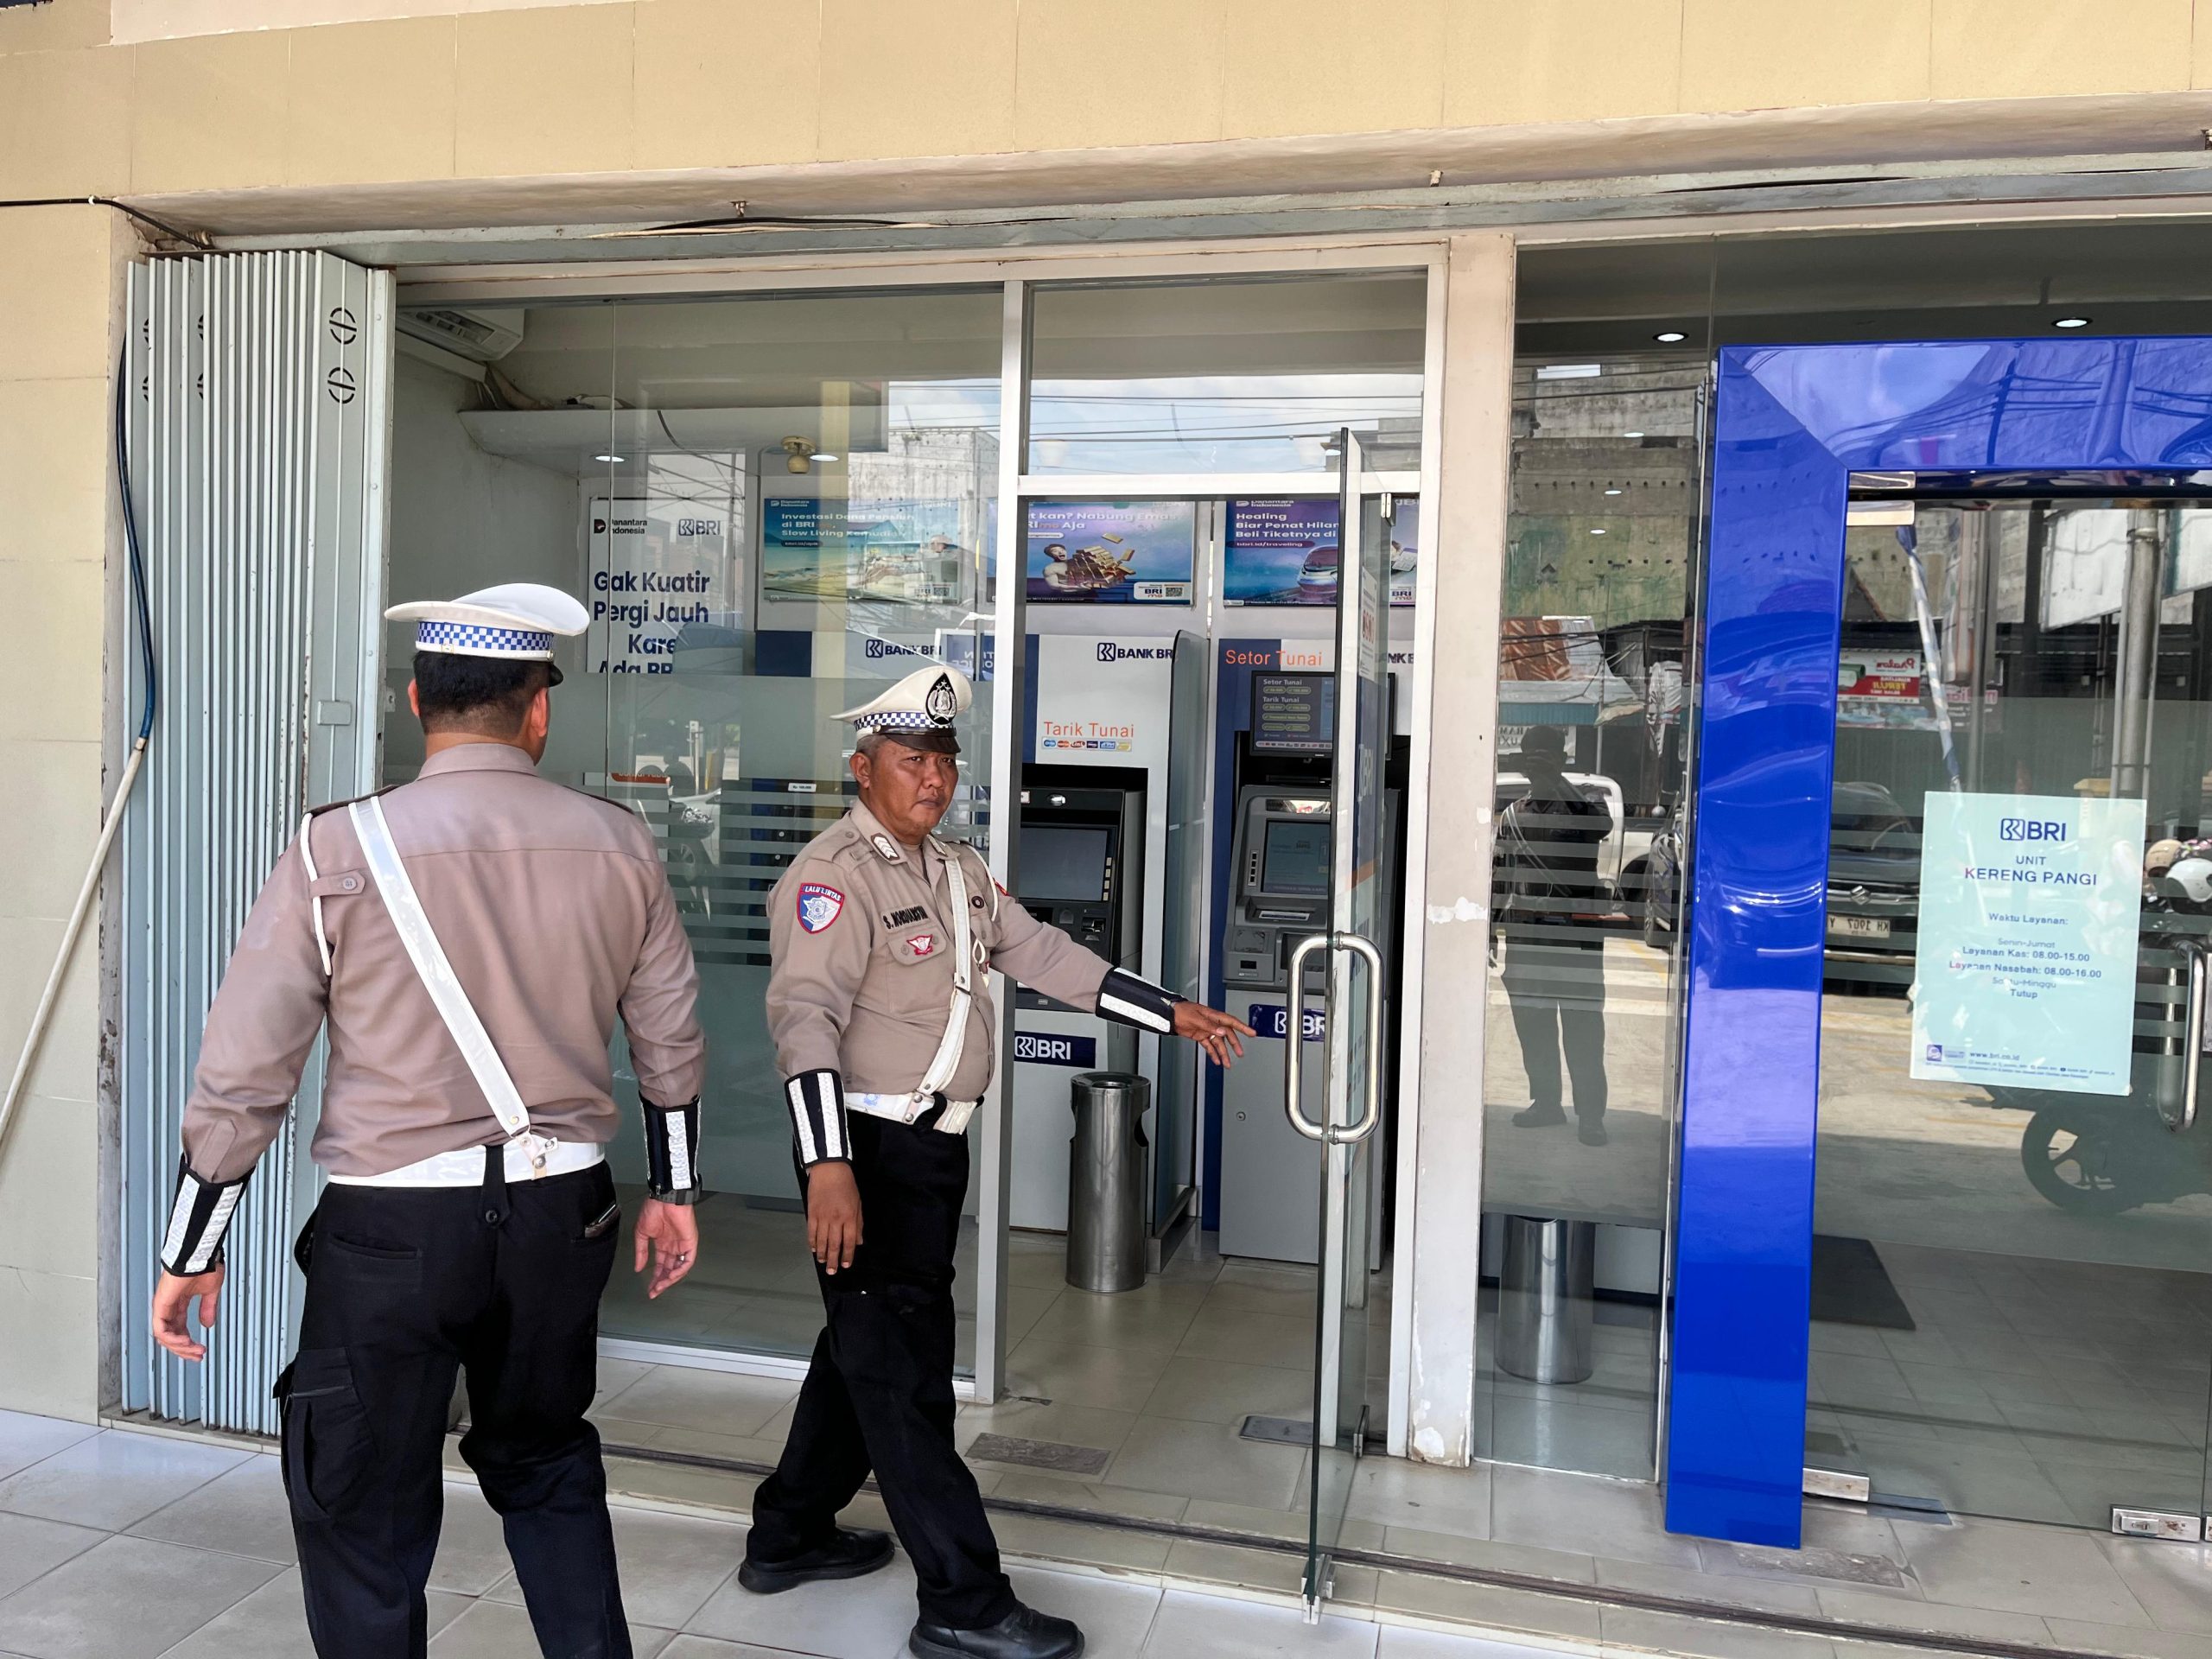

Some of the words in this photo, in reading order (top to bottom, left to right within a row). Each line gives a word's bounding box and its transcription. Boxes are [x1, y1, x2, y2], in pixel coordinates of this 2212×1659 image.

[1077, 512, 1133, 522] Nabung
[1236, 512, 1287, 521] Healing
[695, 520, 721, 536] BRI
[1062, 521, 1086, 531] Aja
[810, 530, 844, 538] Living
[1262, 531, 1320, 539] Tiketnya
[594, 570, 638, 592] Gak
[642, 569, 710, 593] Kuatir
[594, 599, 649, 629] Pergi
[652, 601, 709, 622] Jauh
[1117, 648, 1153, 659] BANK
[1225, 649, 1271, 664] Setor
[1274, 650, 1323, 666] Tunai
[1043, 721, 1084, 736] Tarik
[1089, 722, 1135, 738] Tunai
[2027, 821, 2067, 842] BRI
[2016, 855, 2047, 866] UNIT
[1965, 867, 2037, 883] KERENG
[2043, 871, 2097, 886] PANGI
[821, 887, 842, 901] LINTAS
[1988, 912, 2020, 923] Waktu
[2023, 914, 2069, 925] Layanan:
[1997, 938, 2056, 949] Senin-Jumat
[1962, 946, 2005, 957] Layanan
[2007, 949, 2030, 958] Kas:
[2032, 950, 2090, 962] 08.00-15.00
[1949, 960, 1992, 971] Layanan
[1994, 963, 2042, 975] Nasabah:
[2044, 967, 2102, 978] 08.00-16.00
[1992, 976, 2056, 989] Satu-Minggu
[2010, 988, 2038, 1000] Tutup
[1037, 1039, 1071, 1060] BRI
